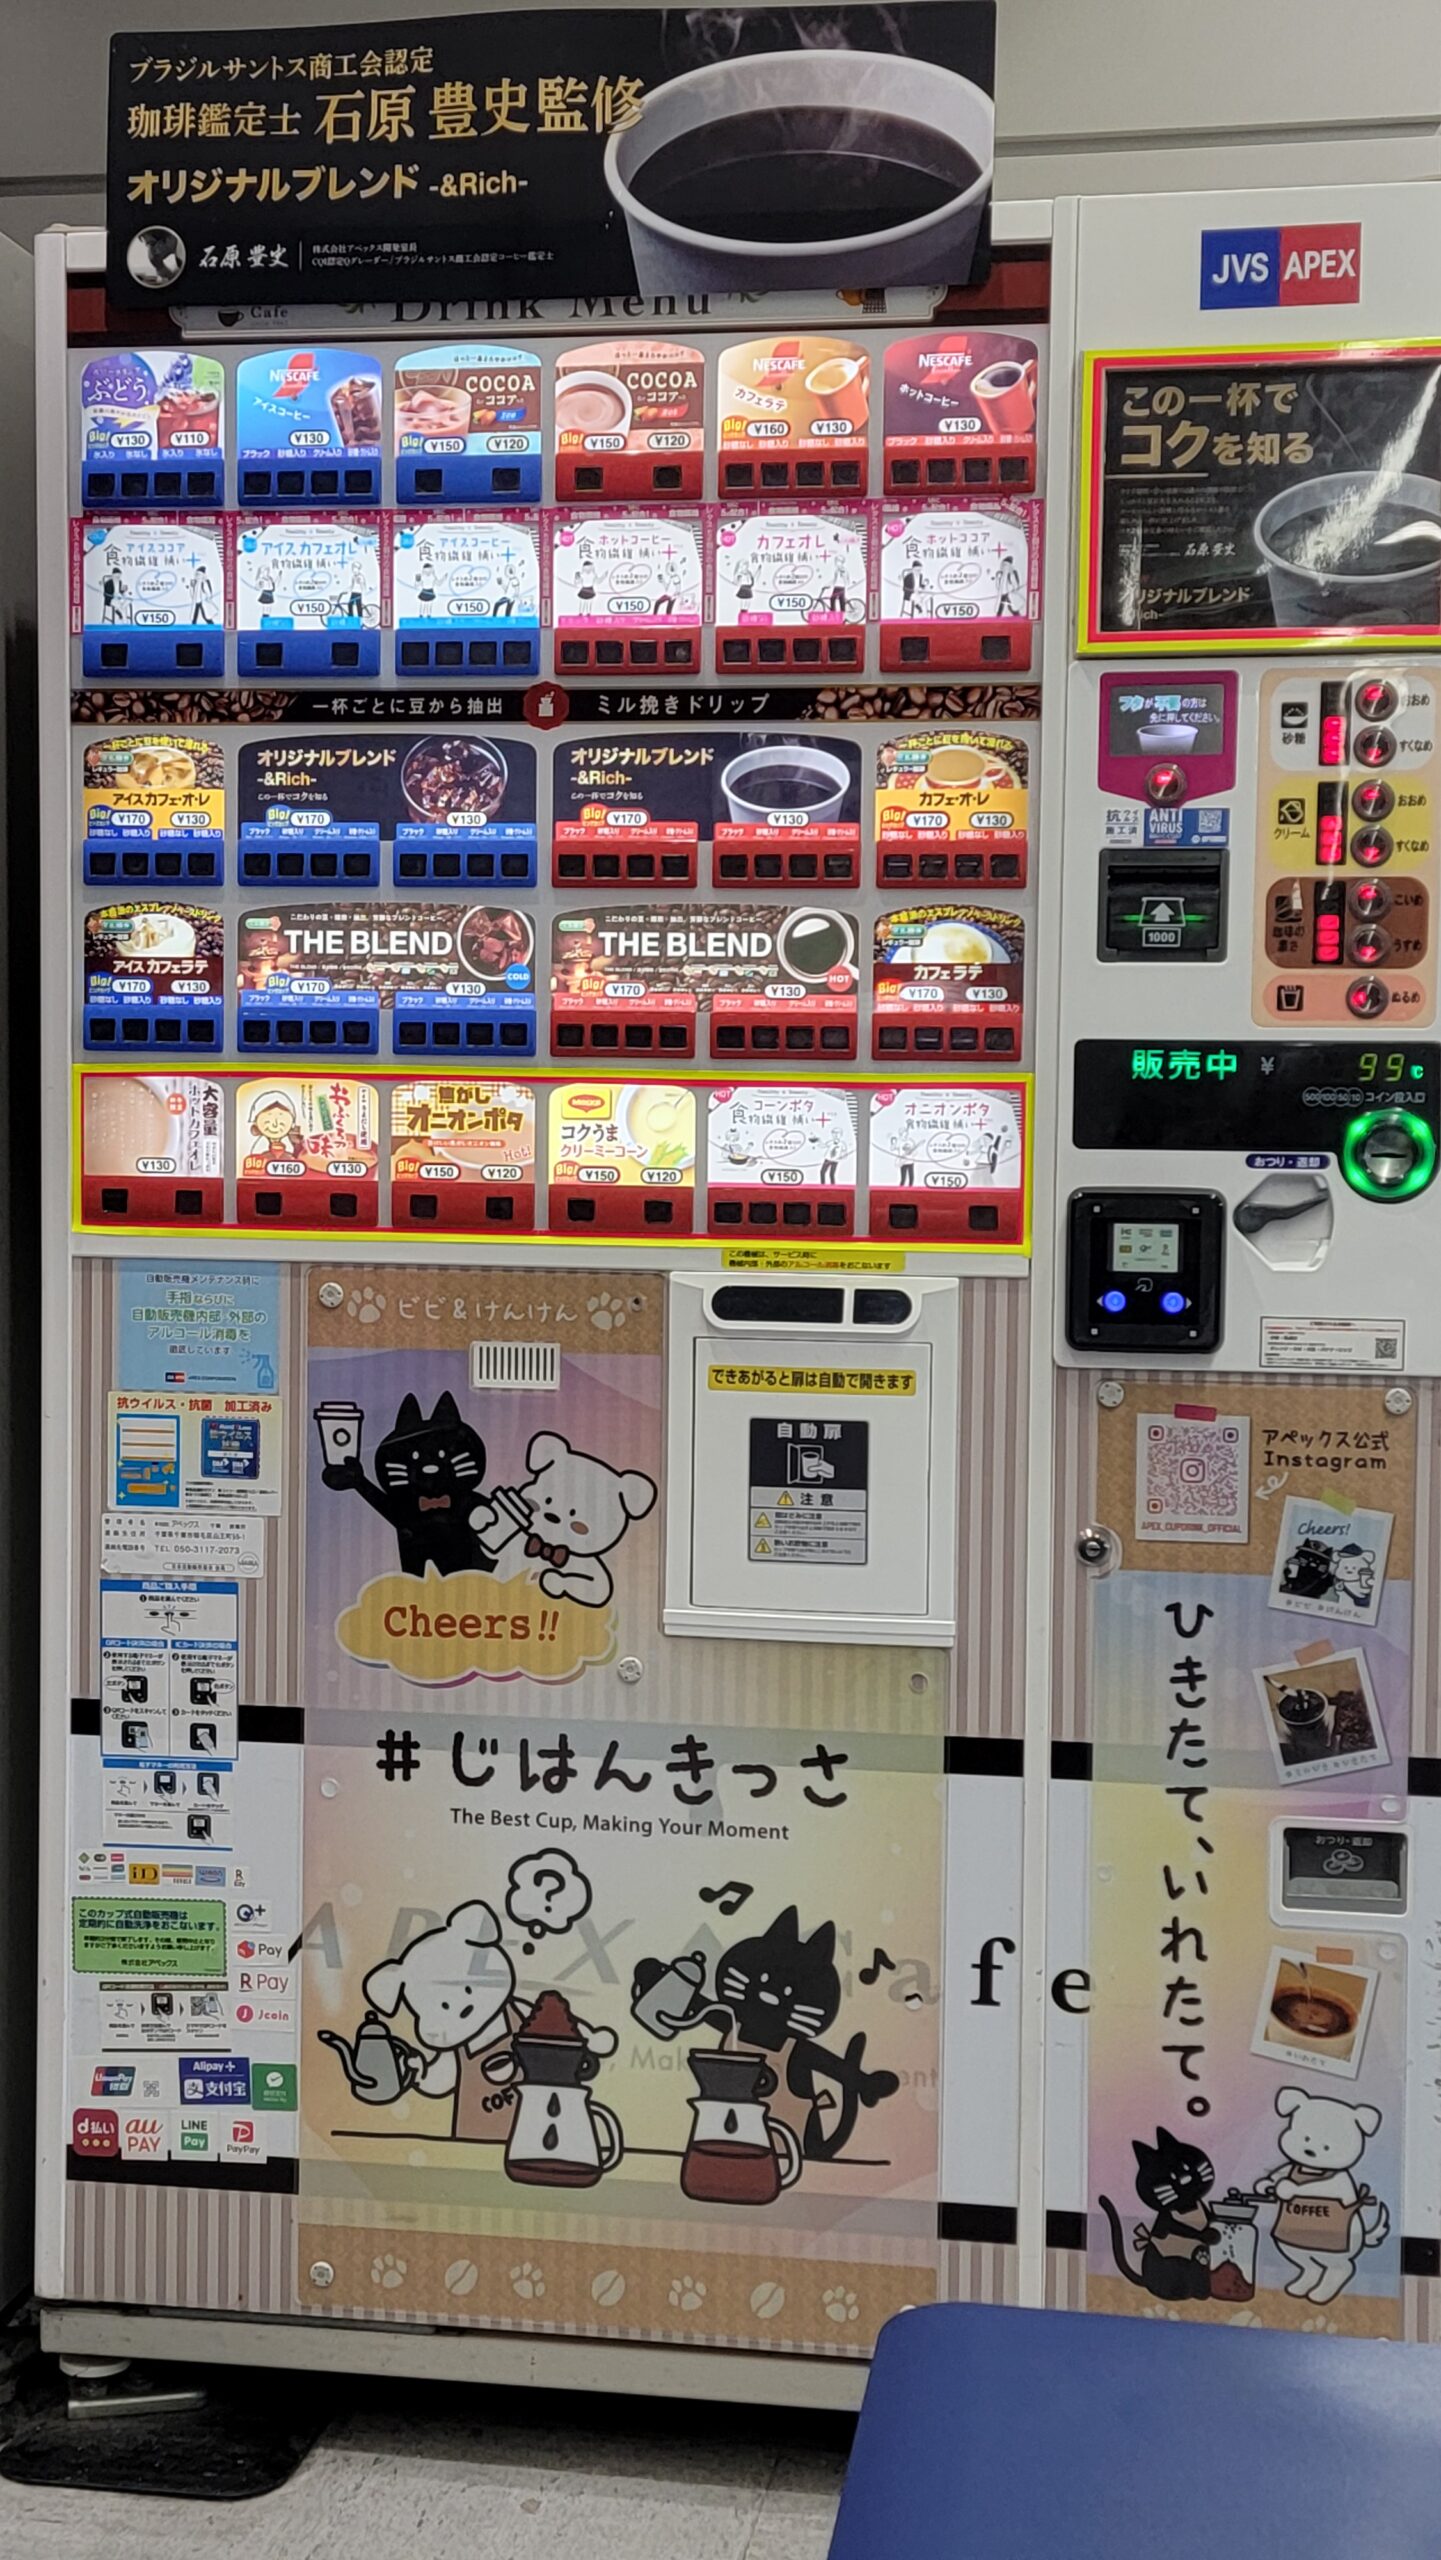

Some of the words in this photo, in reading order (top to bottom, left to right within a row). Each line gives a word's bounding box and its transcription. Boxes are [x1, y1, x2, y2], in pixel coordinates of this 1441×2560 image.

[129, 46, 434, 83] ブラジルサントス商工会認定
[128, 103, 302, 140] 珈琲鑑定士
[316, 84, 415, 144] 石原
[429, 75, 648, 141] 豊史監修
[127, 164, 420, 204] オリジナルブレンド
[429, 171, 529, 197] -&Rich-
[1212, 252, 1269, 284] JVS
[1283, 249, 1356, 281] APEX
[466, 376, 536, 392] COCOA
[627, 372, 697, 389] COCOA
[735, 387, 786, 412] カフェラテ
[899, 384, 959, 408] ホットコーヒー
[1122, 382, 1299, 416] この一杯で
[253, 397, 310, 421] アイスコーヒー
[754, 424, 784, 434] ¥160
[816, 422, 847, 433] ¥130
[945, 420, 976, 430] ¥130
[117, 435, 145, 445] ¥130
[176, 434, 204, 444] ¥110
[295, 433, 324, 444] ¥130
[494, 439, 524, 449] ¥120
[591, 438, 620, 449] ¥150
[656, 436, 685, 446] ¥120
[1121, 421, 1314, 468] コクを知る
[431, 441, 460, 451] ¥150
[297, 603, 325, 612] ¥150
[456, 602, 483, 612] ¥150
[616, 601, 643, 611] ¥150
[778, 597, 805, 608] ¥150
[944, 606, 972, 616] ¥150
[143, 613, 168, 623] ¥150
[313, 698, 503, 715] 一杯ごとに豆から抽出
[599, 693, 770, 715] ミル挽きドリップ
[257, 749, 396, 768] オリジナルブレンド
[570, 748, 714, 766] オリジナルブレンド
[257, 772, 317, 786] -&Rich-
[570, 770, 632, 785] -&Rich-
[113, 794, 143, 805] アイス
[119, 815, 145, 824] ¥170
[178, 815, 205, 824] ¥130
[297, 814, 324, 824] ¥170
[452, 814, 480, 824] ¥130
[613, 814, 641, 824] ¥170
[774, 814, 802, 824] ¥130
[914, 816, 942, 826] ¥170
[977, 816, 1007, 825] ¥130
[1150, 808, 1183, 822] ANTI
[1150, 822, 1183, 834] VIRUS
[1274, 828, 1310, 839] クリーム
[284, 930, 343, 955] THE
[351, 931, 453, 956] BLEND
[1148, 932, 1176, 943] 1000
[598, 932, 659, 956] THE
[667, 932, 772, 958] BLEND
[113, 960, 144, 973] アイス
[147, 959, 208, 974] カフェラテ
[914, 965, 983, 980] カフェラテ
[507, 972, 530, 981] COLD
[829, 974, 849, 983] HOT
[119, 982, 146, 991] ¥170
[178, 982, 206, 992] ¥130
[298, 982, 324, 992] ¥170
[452, 984, 480, 995] ¥130
[612, 985, 640, 996] ¥170
[770, 986, 800, 996] ¥130
[909, 989, 938, 998] ¥170
[972, 989, 1003, 999] ¥130
[1132, 1049, 1238, 1081] 販売中
[1359, 1053, 1405, 1082] 99
[439, 1086, 491, 1104] 焦がし
[202, 1086, 219, 1136] 大容量
[754, 1100, 813, 1113] コーンポタ
[905, 1103, 989, 1116] オニオンポタ
[407, 1104, 524, 1133] オニオンポタ
[561, 1124, 618, 1142] コクうま
[307, 1135, 335, 1158] 味
[560, 1145, 648, 1158] クリーミーコーン
[504, 1146, 532, 1162] Hot!
[142, 1161, 170, 1170] ¥130
[272, 1163, 300, 1173] ¥160
[1254, 1156, 1320, 1168] おつり・返却
[334, 1164, 361, 1174] ¥130
[425, 1168, 453, 1178] ¥150
[488, 1168, 517, 1179] ¥120
[585, 1170, 615, 1181] ¥150
[647, 1171, 676, 1182] ¥120
[768, 1172, 798, 1183] ¥150
[931, 1175, 962, 1187] ¥150
[712, 1368, 913, 1391] できあがると扉は自動で開きます
[117, 1397, 212, 1411] 抗ウイルス・抗菌
[225, 1400, 272, 1413] 加工済み
[1262, 1429, 1390, 1451] アペックス公式
[1263, 1452, 1387, 1473] Instagram
[1298, 1521, 1351, 1537] Cheers!
[174, 1546, 240, 1554] 050-3117-2073
[384, 1605, 560, 1642] Cheers!!
[375, 1729, 849, 1809] #じはんきっさ
[450, 1806, 485, 1828] The
[490, 1809, 531, 1829] Best
[535, 1811, 578, 1835] Cup,
[582, 1814, 653, 1838] Making
[659, 1817, 703, 1838] Your
[708, 1820, 790, 1841] Moment
[1162, 1602, 1215, 2119] ひきたて、いれたて。
[258, 1943, 282, 1958] Pay
[257, 1974, 288, 1993] Pay
[205, 2081, 246, 2096] 支付宝
[125, 2118, 163, 2133] au
[181, 2120, 208, 2130] LINE
[128, 2136, 161, 2152] PAY
[184, 2137, 205, 2147] Pay
[227, 2145, 260, 2155] PayPay
[1286, 2202, 1330, 2217] COFFEE
